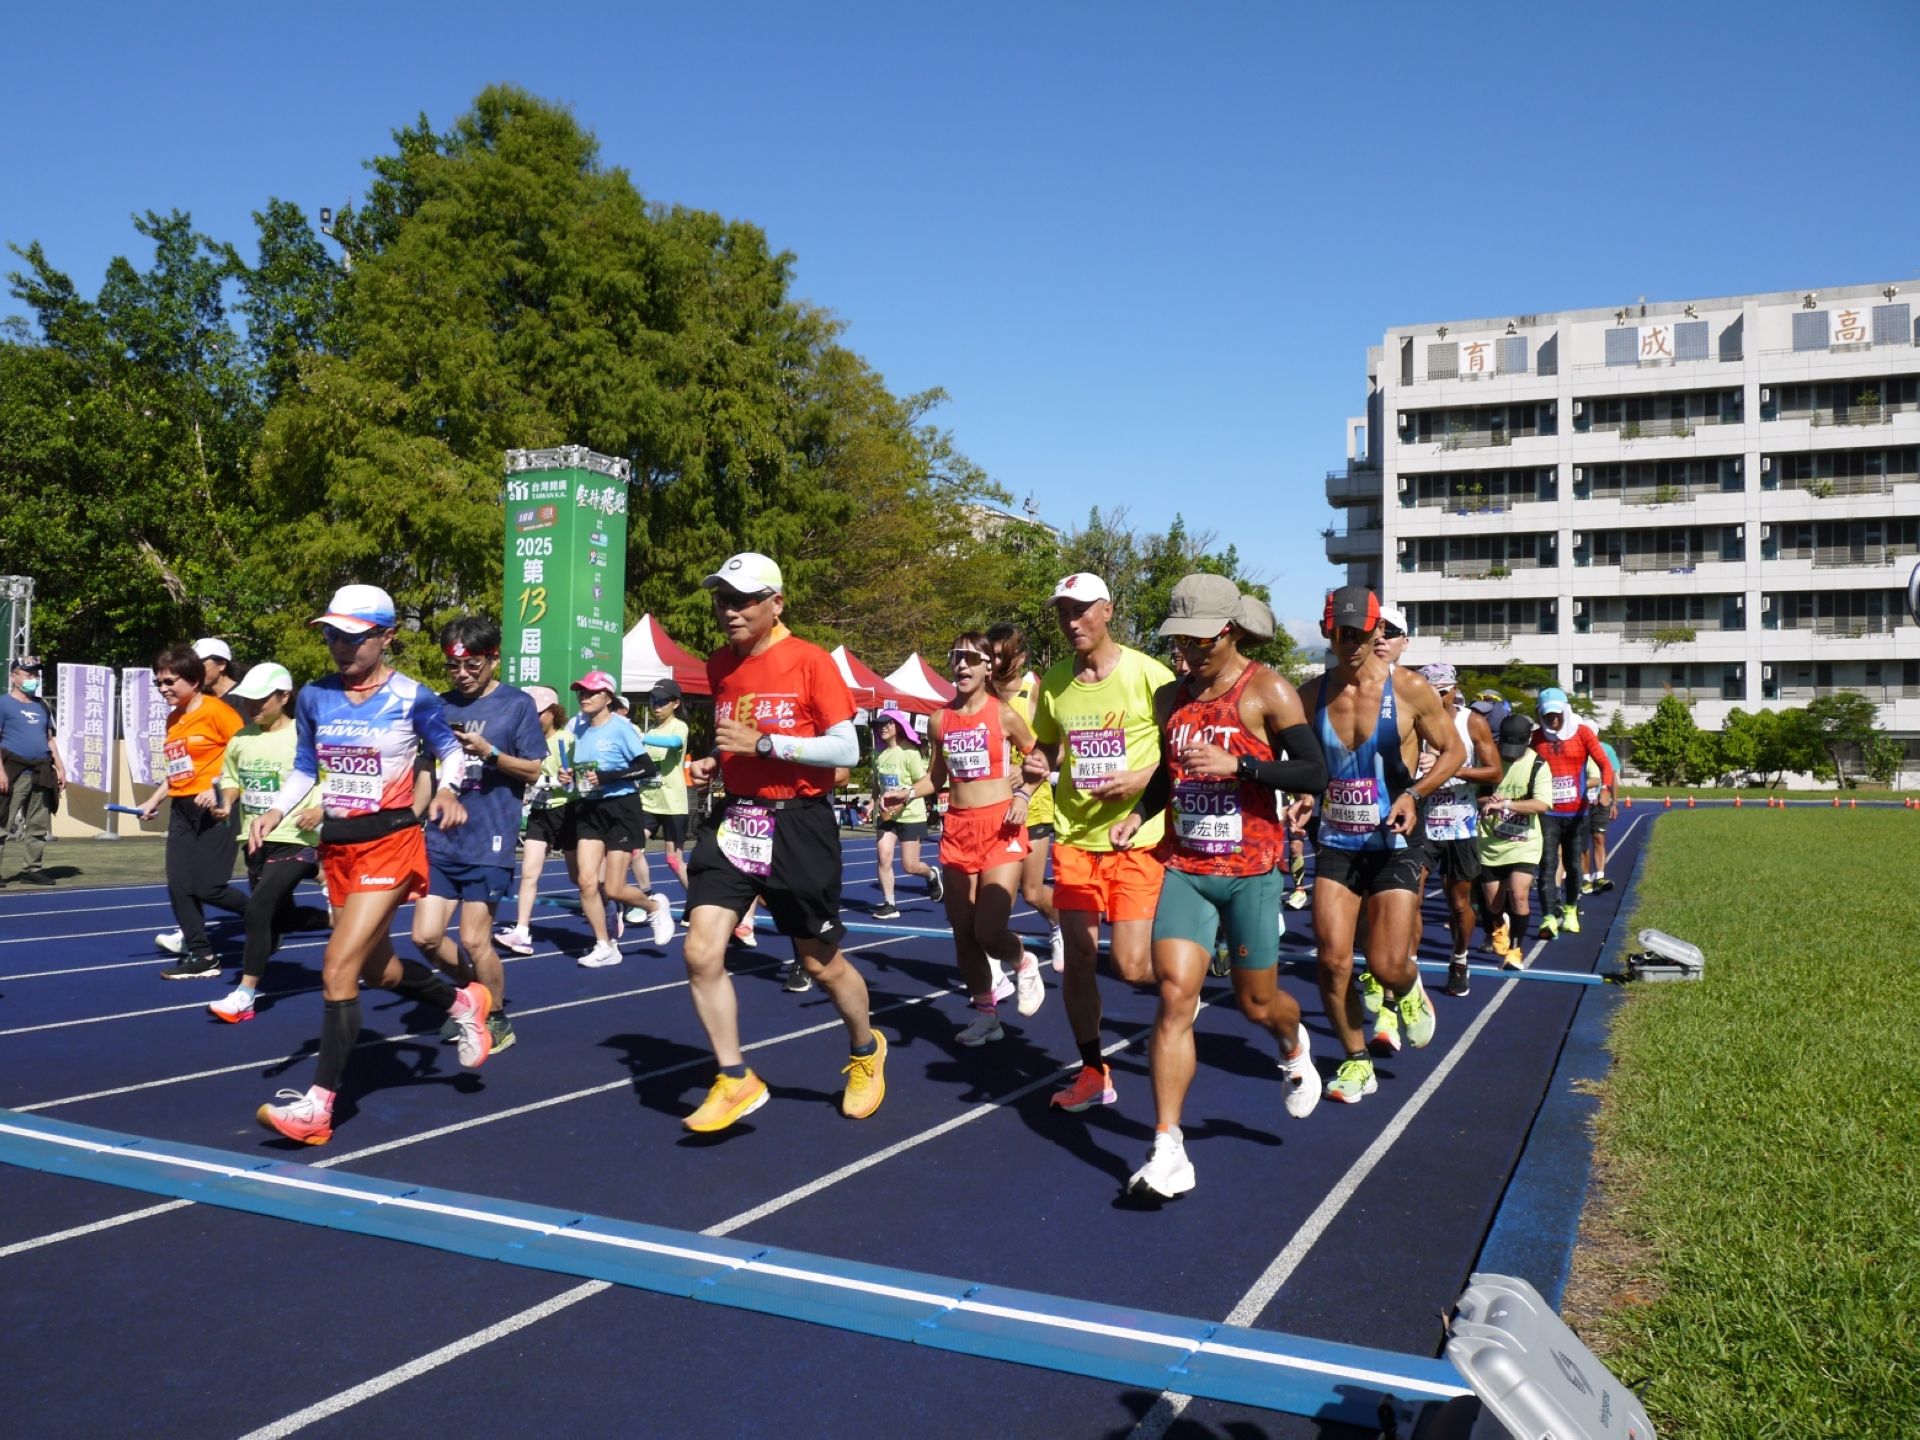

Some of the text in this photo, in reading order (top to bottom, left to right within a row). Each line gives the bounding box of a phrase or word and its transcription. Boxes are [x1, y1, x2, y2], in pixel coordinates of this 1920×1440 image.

[1463, 310, 1866, 373] 育 成 高
[516, 537, 552, 557] 2025
[317, 724, 389, 738] TAIWAN
[950, 738, 985, 753] 5042
[1081, 740, 1122, 757] 5003
[331, 757, 378, 775] 5028
[246, 778, 275, 793] 23-1
[1185, 794, 1236, 814] 5015
[1332, 789, 1372, 805] 5001
[733, 816, 770, 838] 5002
